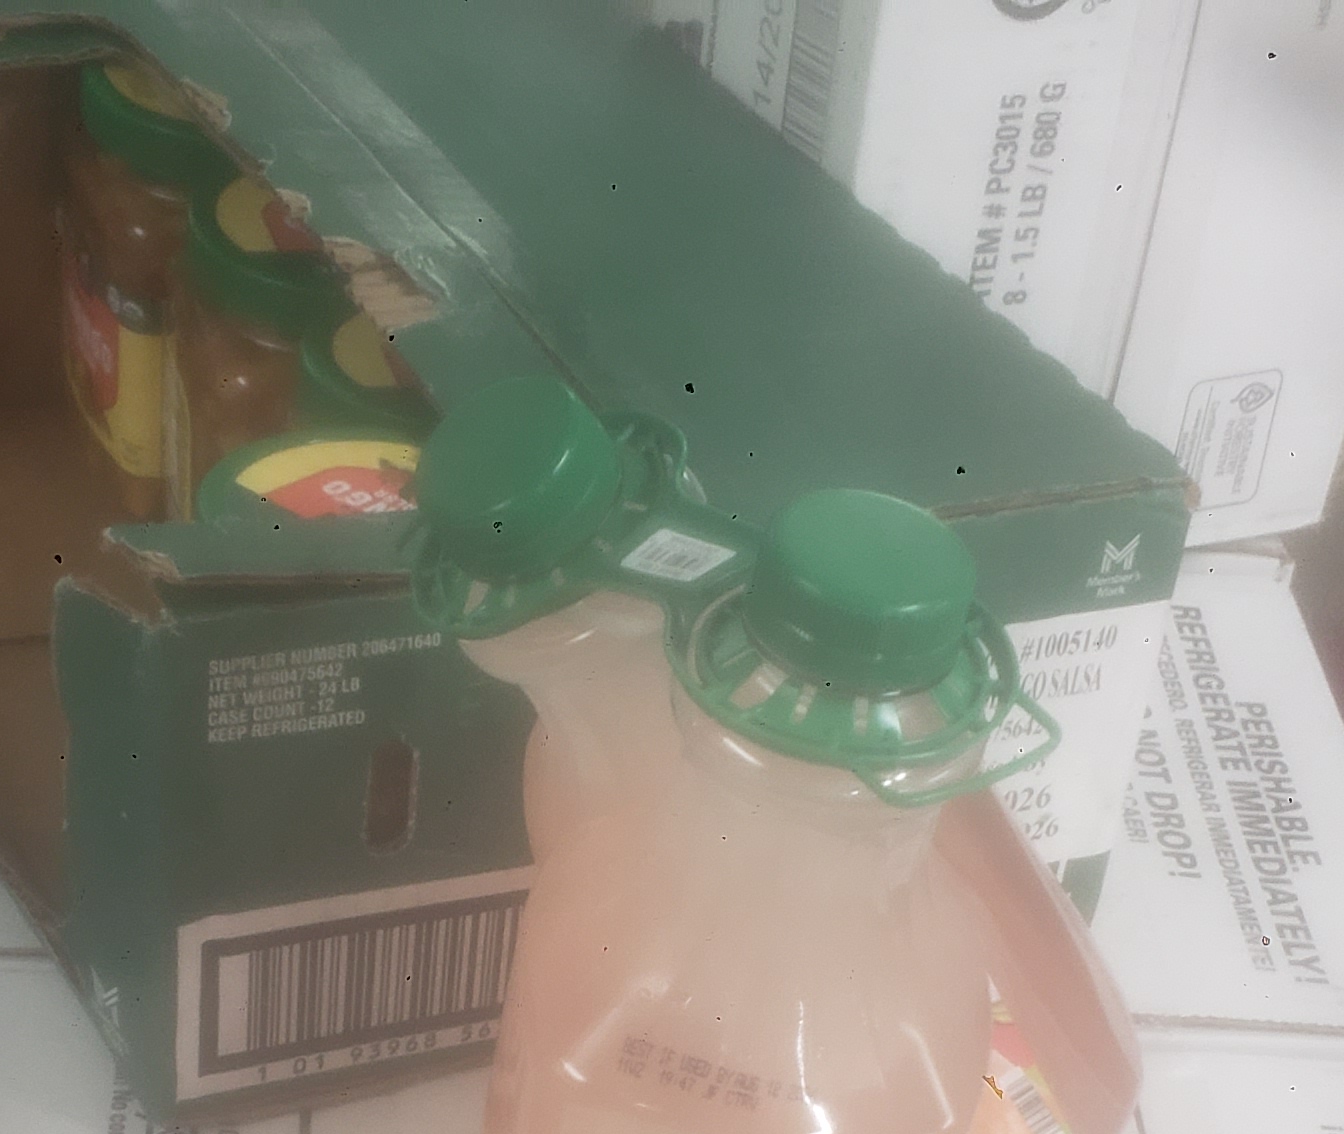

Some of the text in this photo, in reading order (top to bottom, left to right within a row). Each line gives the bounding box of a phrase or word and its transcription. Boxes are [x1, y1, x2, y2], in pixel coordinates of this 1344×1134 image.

[985, 93, 1026, 197] PC3015
[1003, 81, 1068, 305] 8 1.5 LB 680 G
[982, 203, 1008, 220] #
[209, 652, 286, 676] SUPPLIER
[291, 642, 356, 665] NUMBER
[1020, 625, 1118, 663] #1005140
[209, 675, 246, 692] ITEM
[209, 677, 360, 710] NET WEIGHT 24 LB
[1048, 662, 1102, 698] SALSA
[209, 710, 248, 727] CASE
[253, 701, 305, 721] COUNT
[209, 710, 366, 744] KEEP REFRIGERATED
[1134, 728, 1202, 879] NOT DROP!
[1170, 604, 1330, 985] REFRIGERATE IMMEDIATELY!
[350, 1032, 438, 1062] 93968
